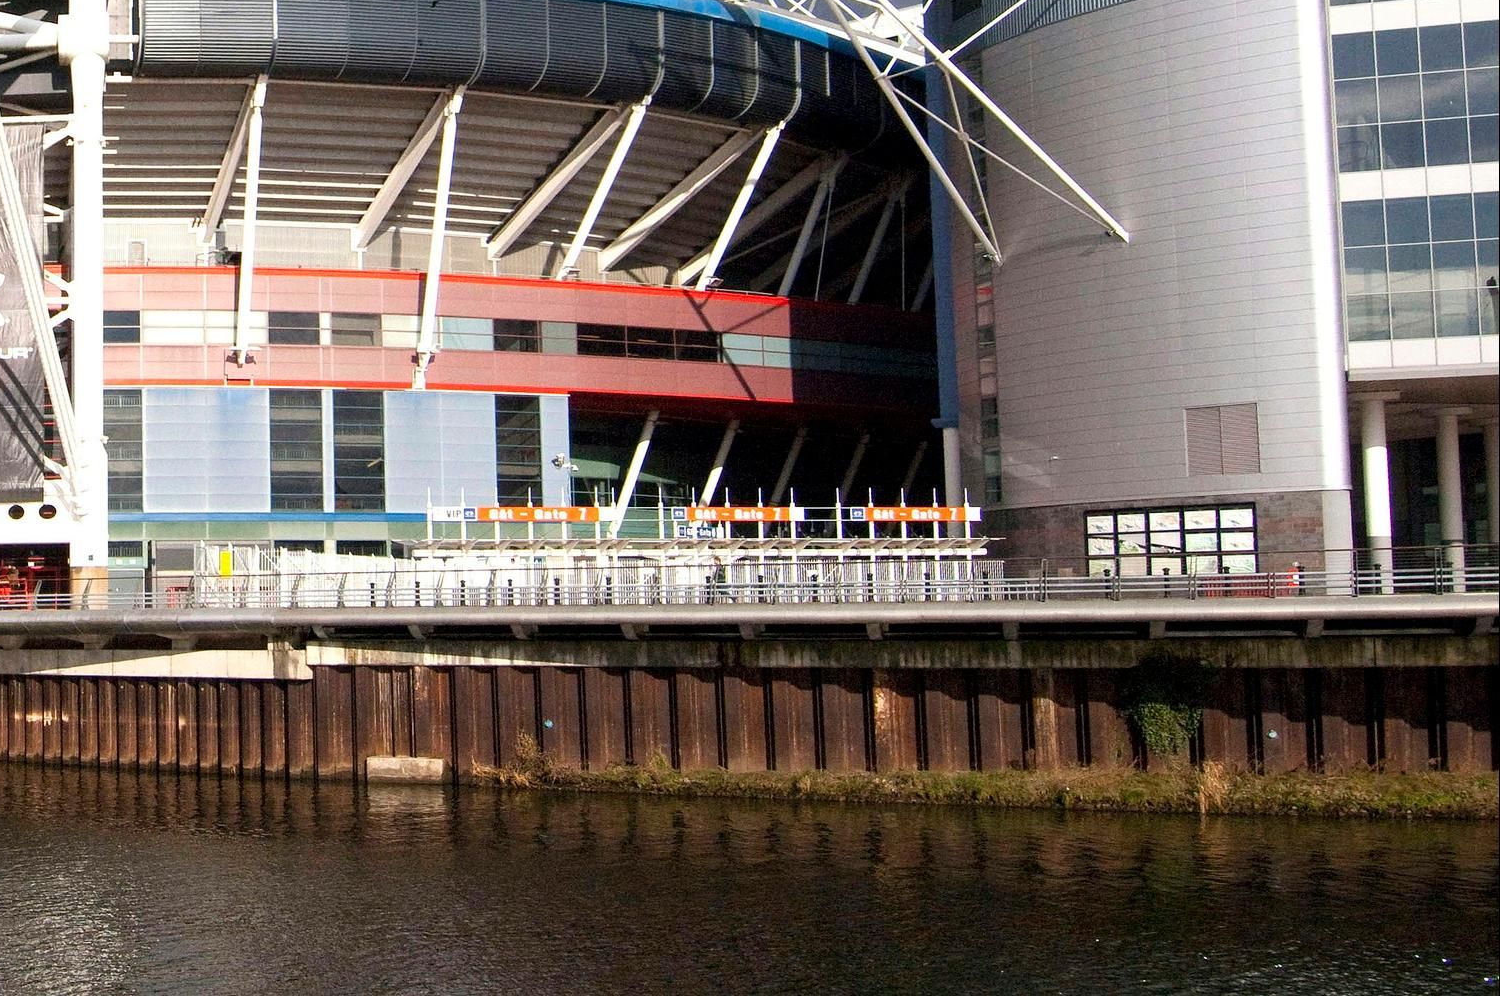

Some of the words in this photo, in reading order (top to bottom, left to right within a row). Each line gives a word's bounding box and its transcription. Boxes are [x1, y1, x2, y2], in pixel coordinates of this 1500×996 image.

[446, 510, 461, 518] VIP
[578, 508, 587, 520] 7
[772, 508, 781, 520] 7
[949, 508, 957, 520] 7
